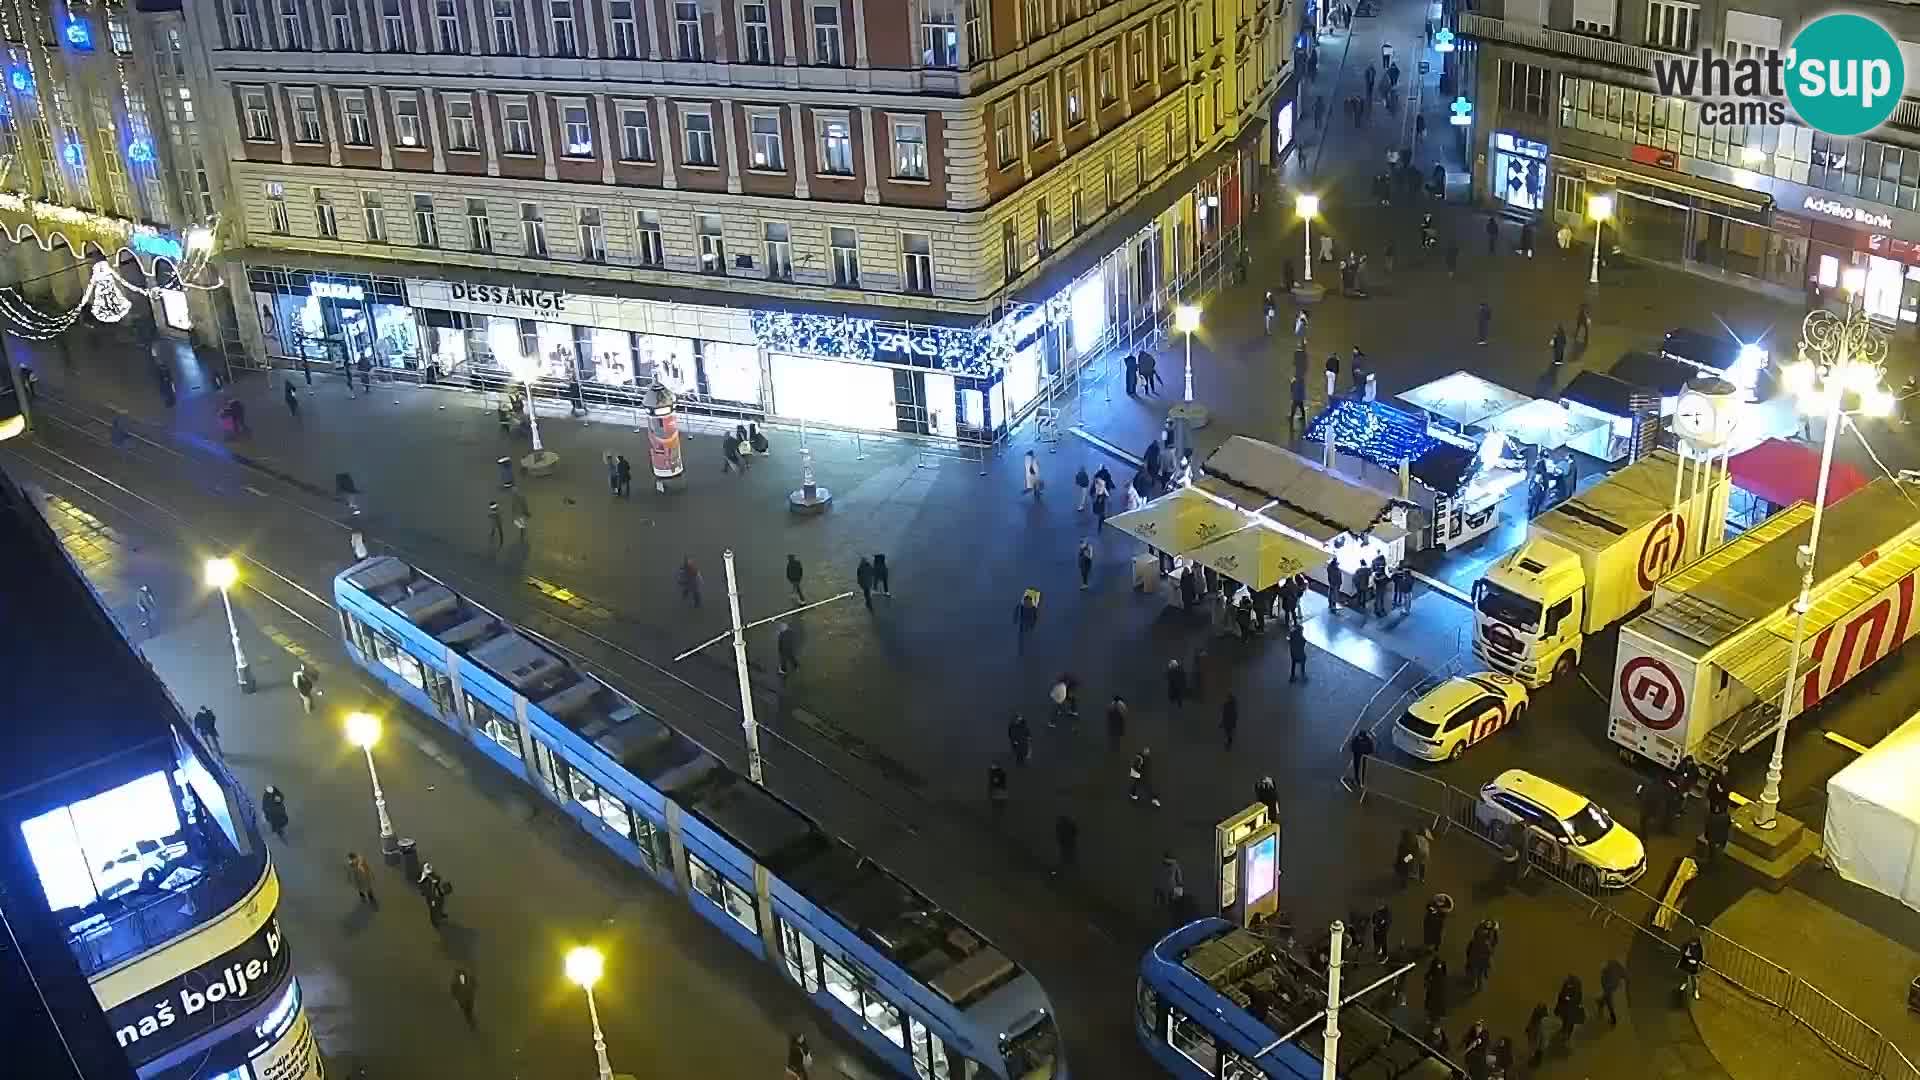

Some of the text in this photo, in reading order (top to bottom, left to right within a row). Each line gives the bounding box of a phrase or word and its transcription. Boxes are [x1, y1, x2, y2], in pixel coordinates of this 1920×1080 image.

[1855, 208, 1892, 229] Bank
[451, 283, 565, 311] DESSANGE
[115, 999, 176, 1048] naš
